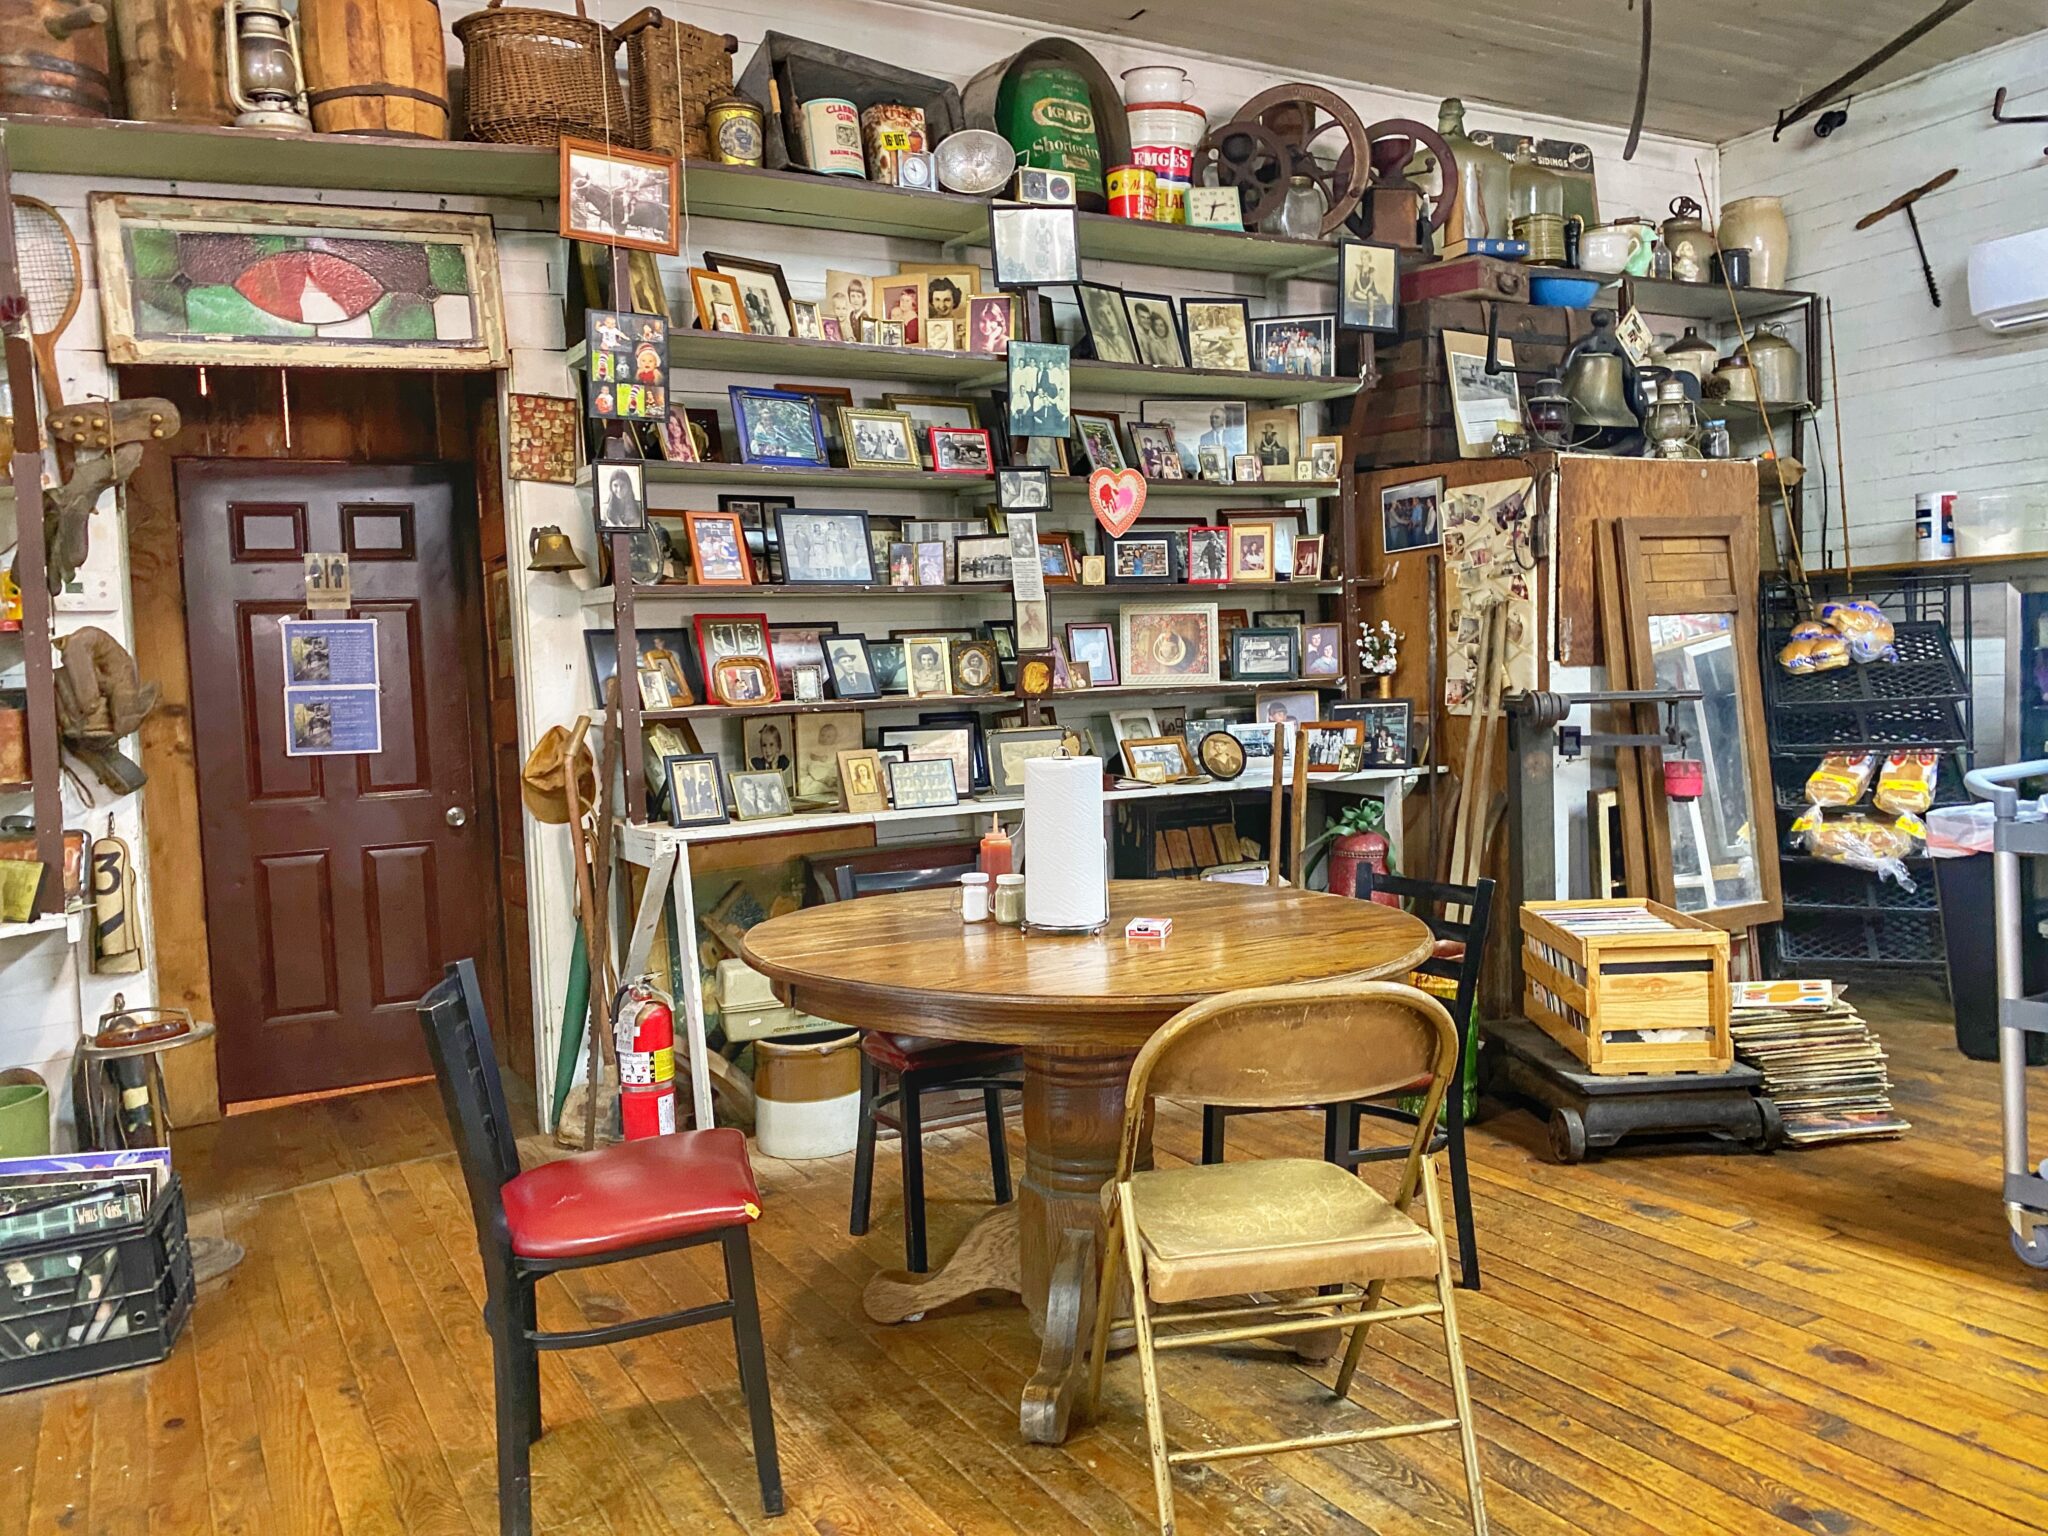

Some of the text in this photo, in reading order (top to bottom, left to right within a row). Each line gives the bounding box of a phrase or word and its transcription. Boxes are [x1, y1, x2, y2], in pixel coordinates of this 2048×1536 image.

[837, 113, 854, 123] GIRL
[1047, 106, 1089, 125] KRAFT
[1033, 136, 1100, 160] Shortenin
[1538, 156, 1568, 168] SIDINGS
[95, 851, 121, 895] 3
